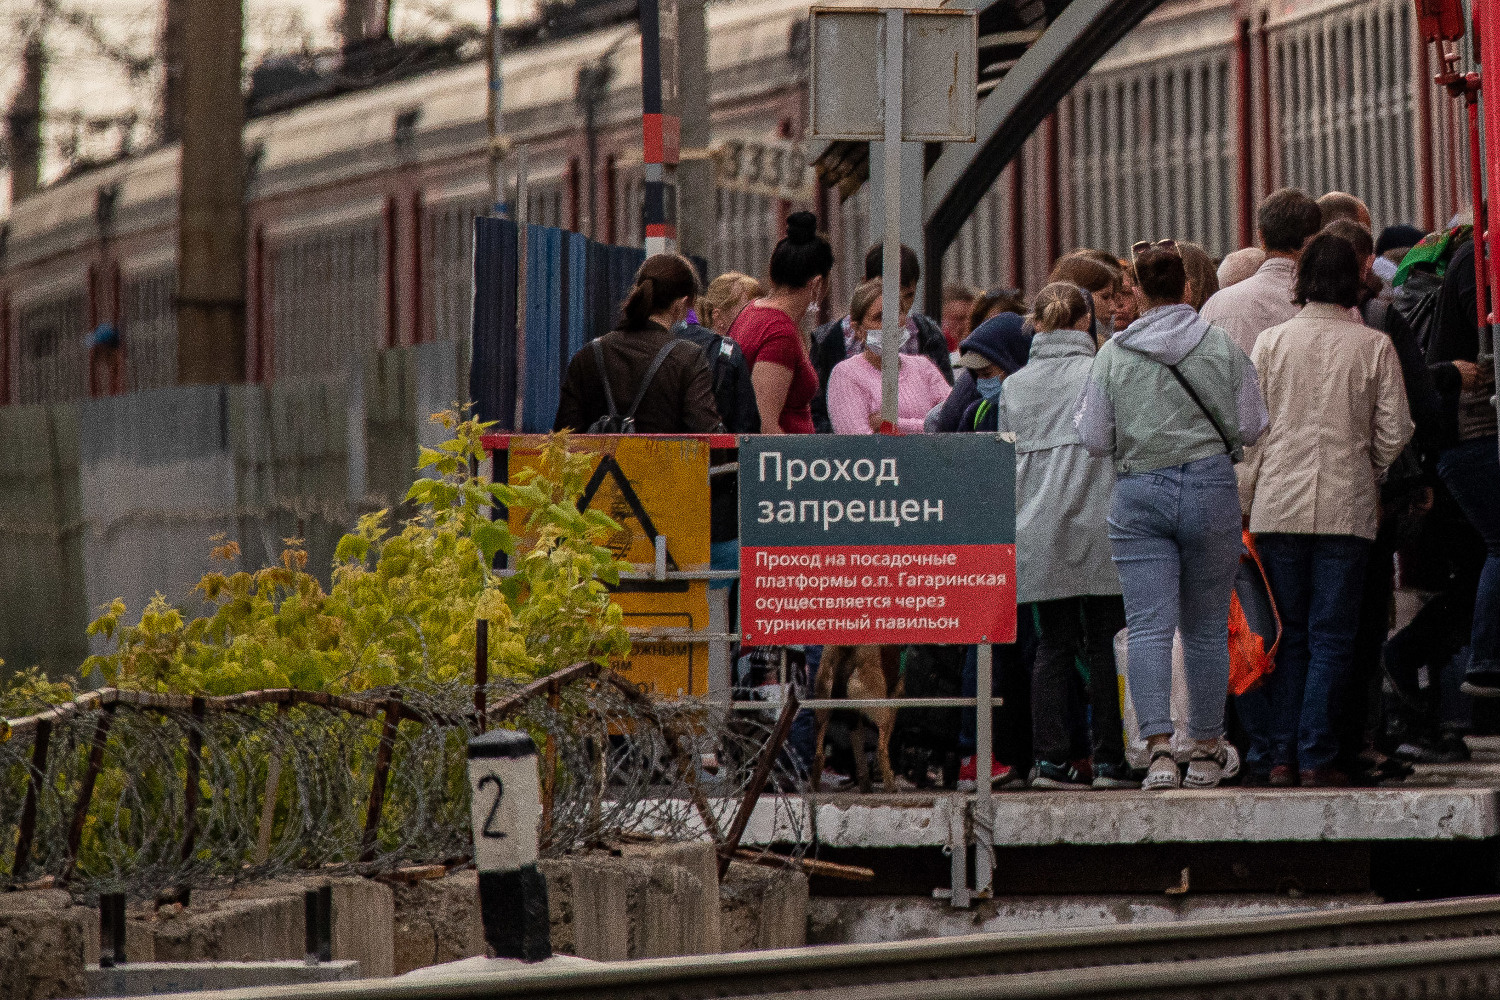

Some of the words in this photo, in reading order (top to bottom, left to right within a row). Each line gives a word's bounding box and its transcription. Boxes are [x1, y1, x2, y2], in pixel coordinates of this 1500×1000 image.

[759, 452, 899, 490] Проход
[758, 500, 943, 530] запрещен
[756, 552, 821, 570] Проход
[825, 554, 845, 566] на
[851, 553, 956, 568] посадочные
[756, 574, 856, 590] платформы
[862, 577, 893, 588] о.п.
[899, 573, 1006, 589] Гагаринская
[756, 596, 891, 612] осуществляется
[896, 596, 945, 610] через
[756, 616, 870, 633] турникетный
[875, 618, 959, 629] павильон
[478, 773, 507, 838] 2
